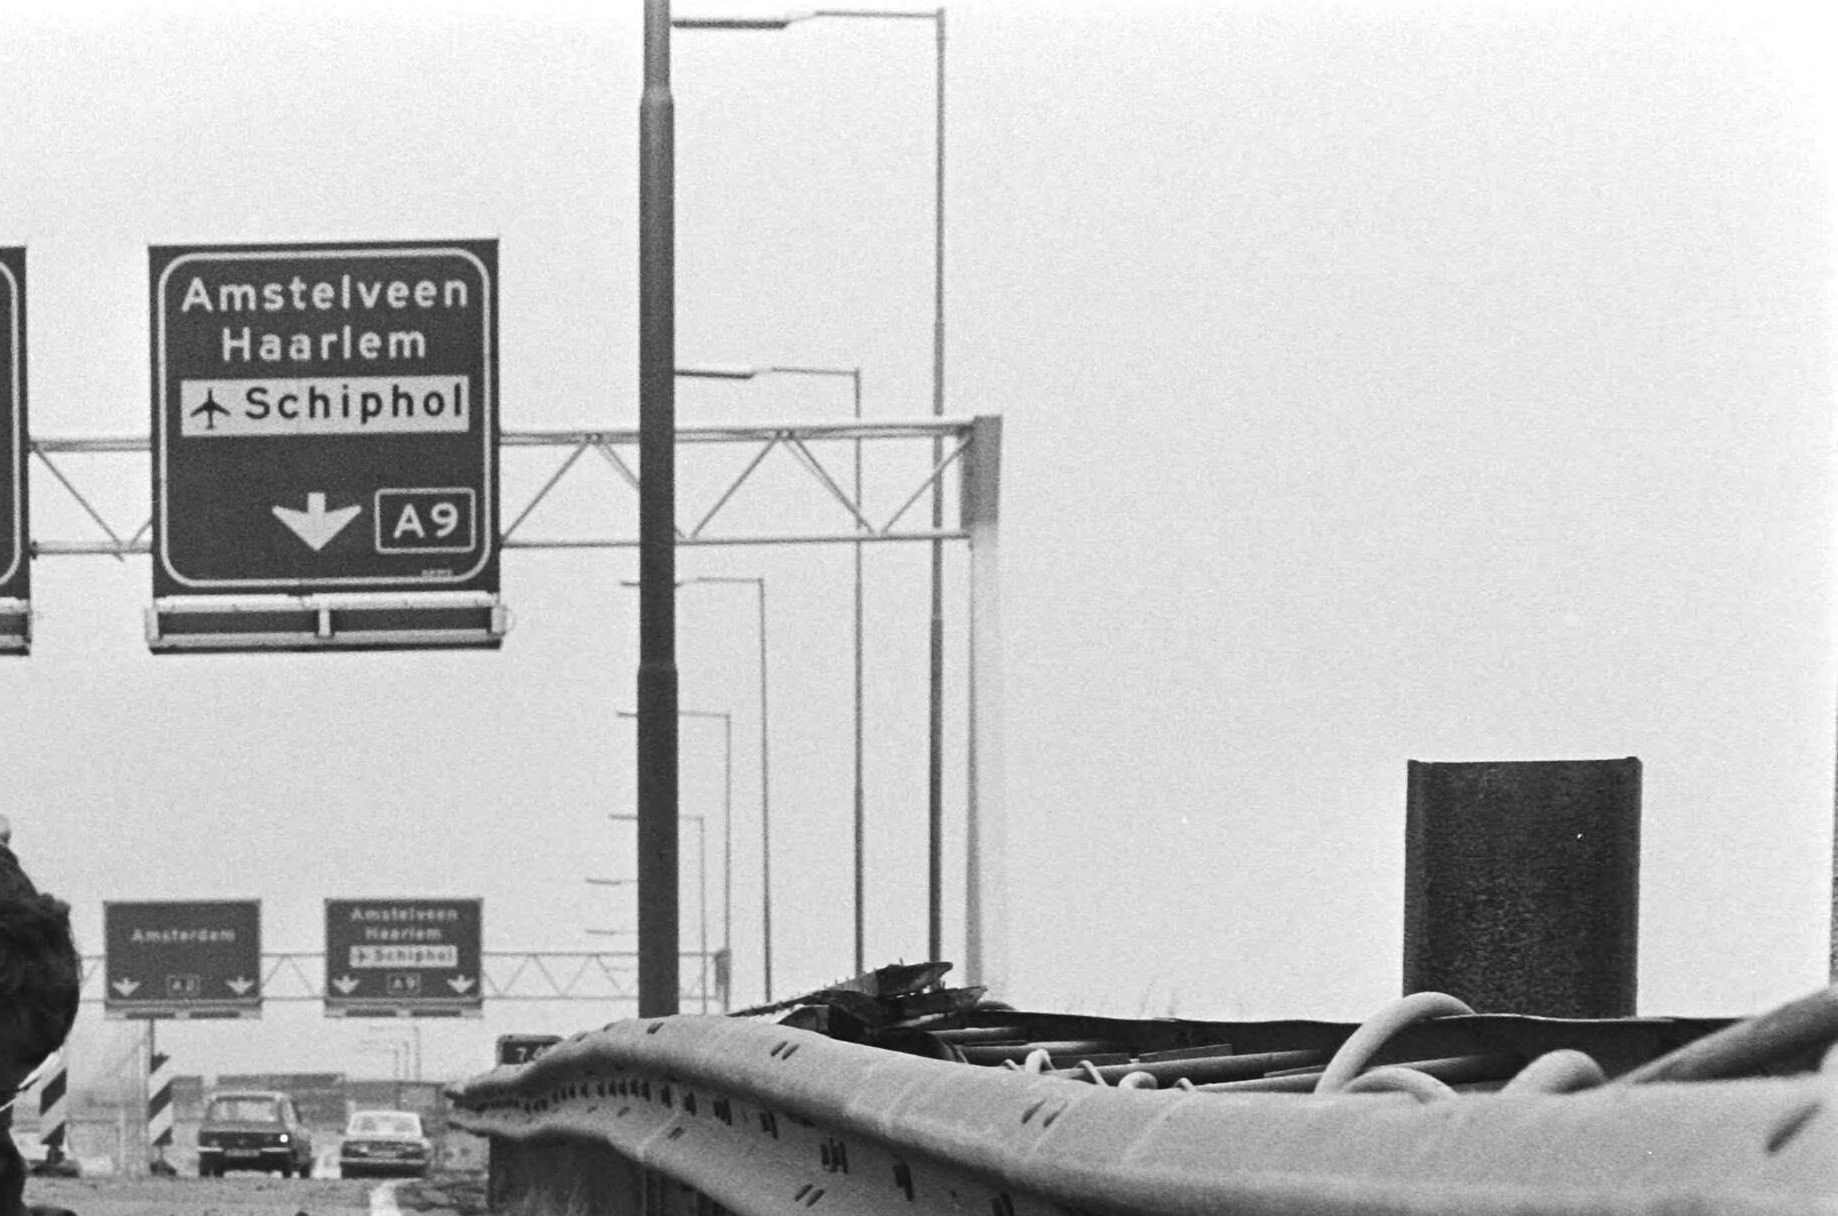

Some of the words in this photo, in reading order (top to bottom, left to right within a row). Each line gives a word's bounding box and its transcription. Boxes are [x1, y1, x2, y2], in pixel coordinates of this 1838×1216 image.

[181, 275, 469, 311] Amstelveen
[221, 325, 427, 362] Haarlem
[244, 381, 464, 425] Schiphol
[392, 501, 459, 539] A9
